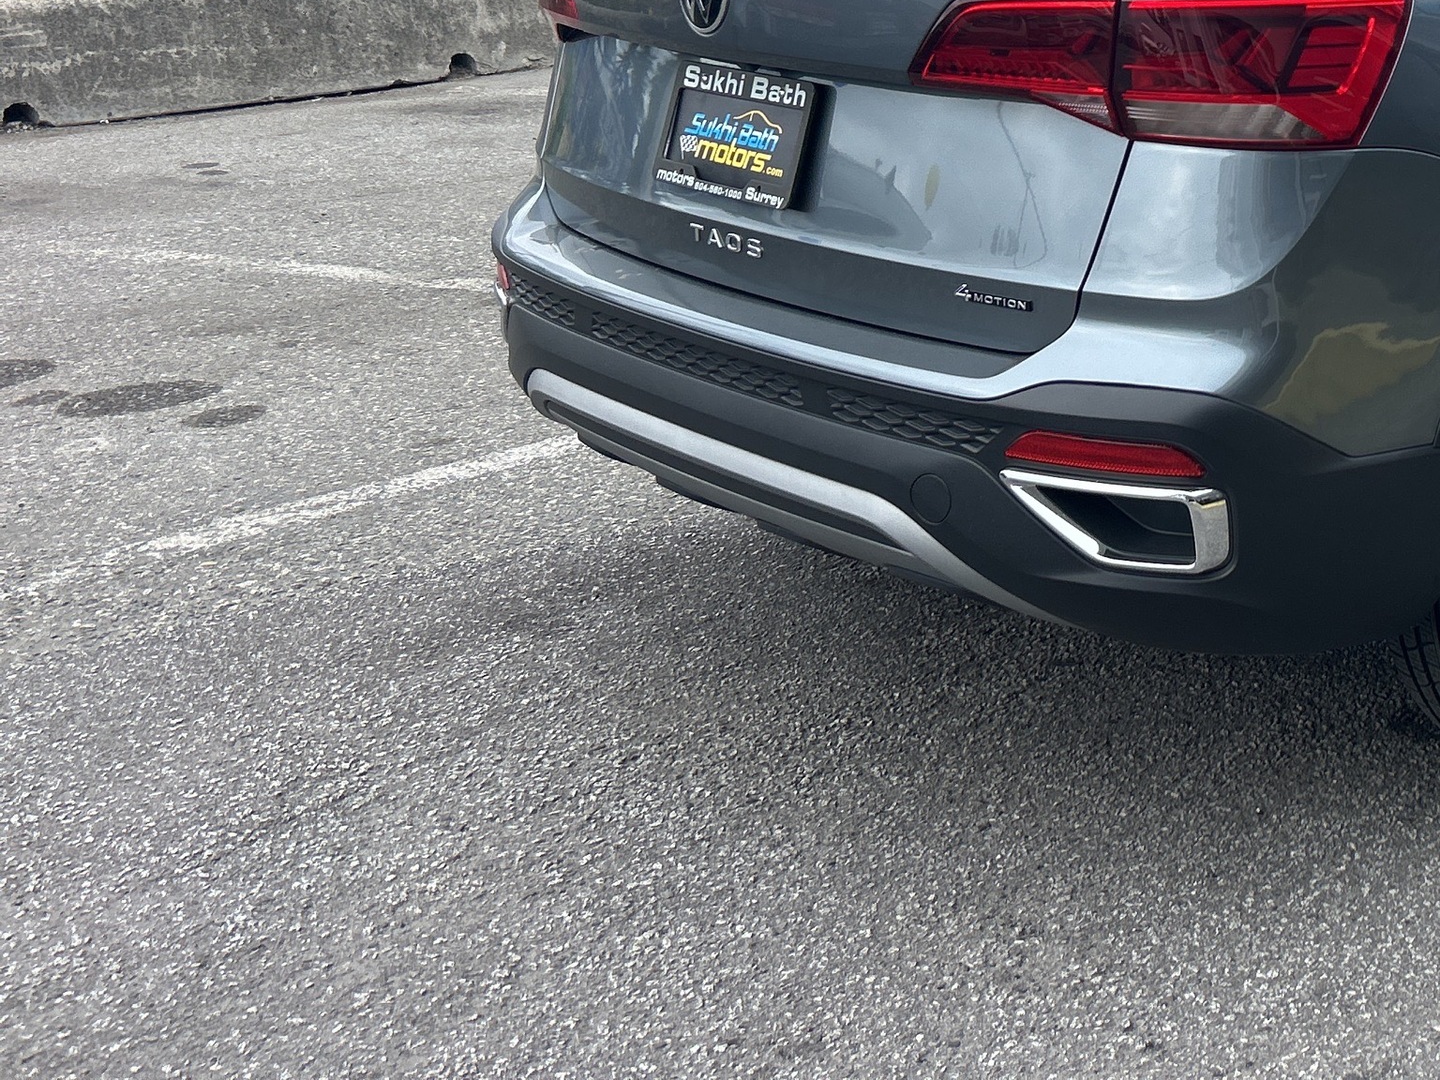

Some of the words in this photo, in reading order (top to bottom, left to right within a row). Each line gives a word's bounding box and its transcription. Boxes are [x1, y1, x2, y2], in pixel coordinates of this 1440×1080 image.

[683, 64, 746, 96] Sukhi
[750, 76, 807, 108] Bath
[684, 112, 739, 143] Sukhi
[738, 123, 780, 152] Bath
[656, 168, 695, 187] motors
[745, 186, 785, 209] Surrey
[689, 222, 764, 259] TAOS
[955, 283, 1027, 311] 4MOTION
